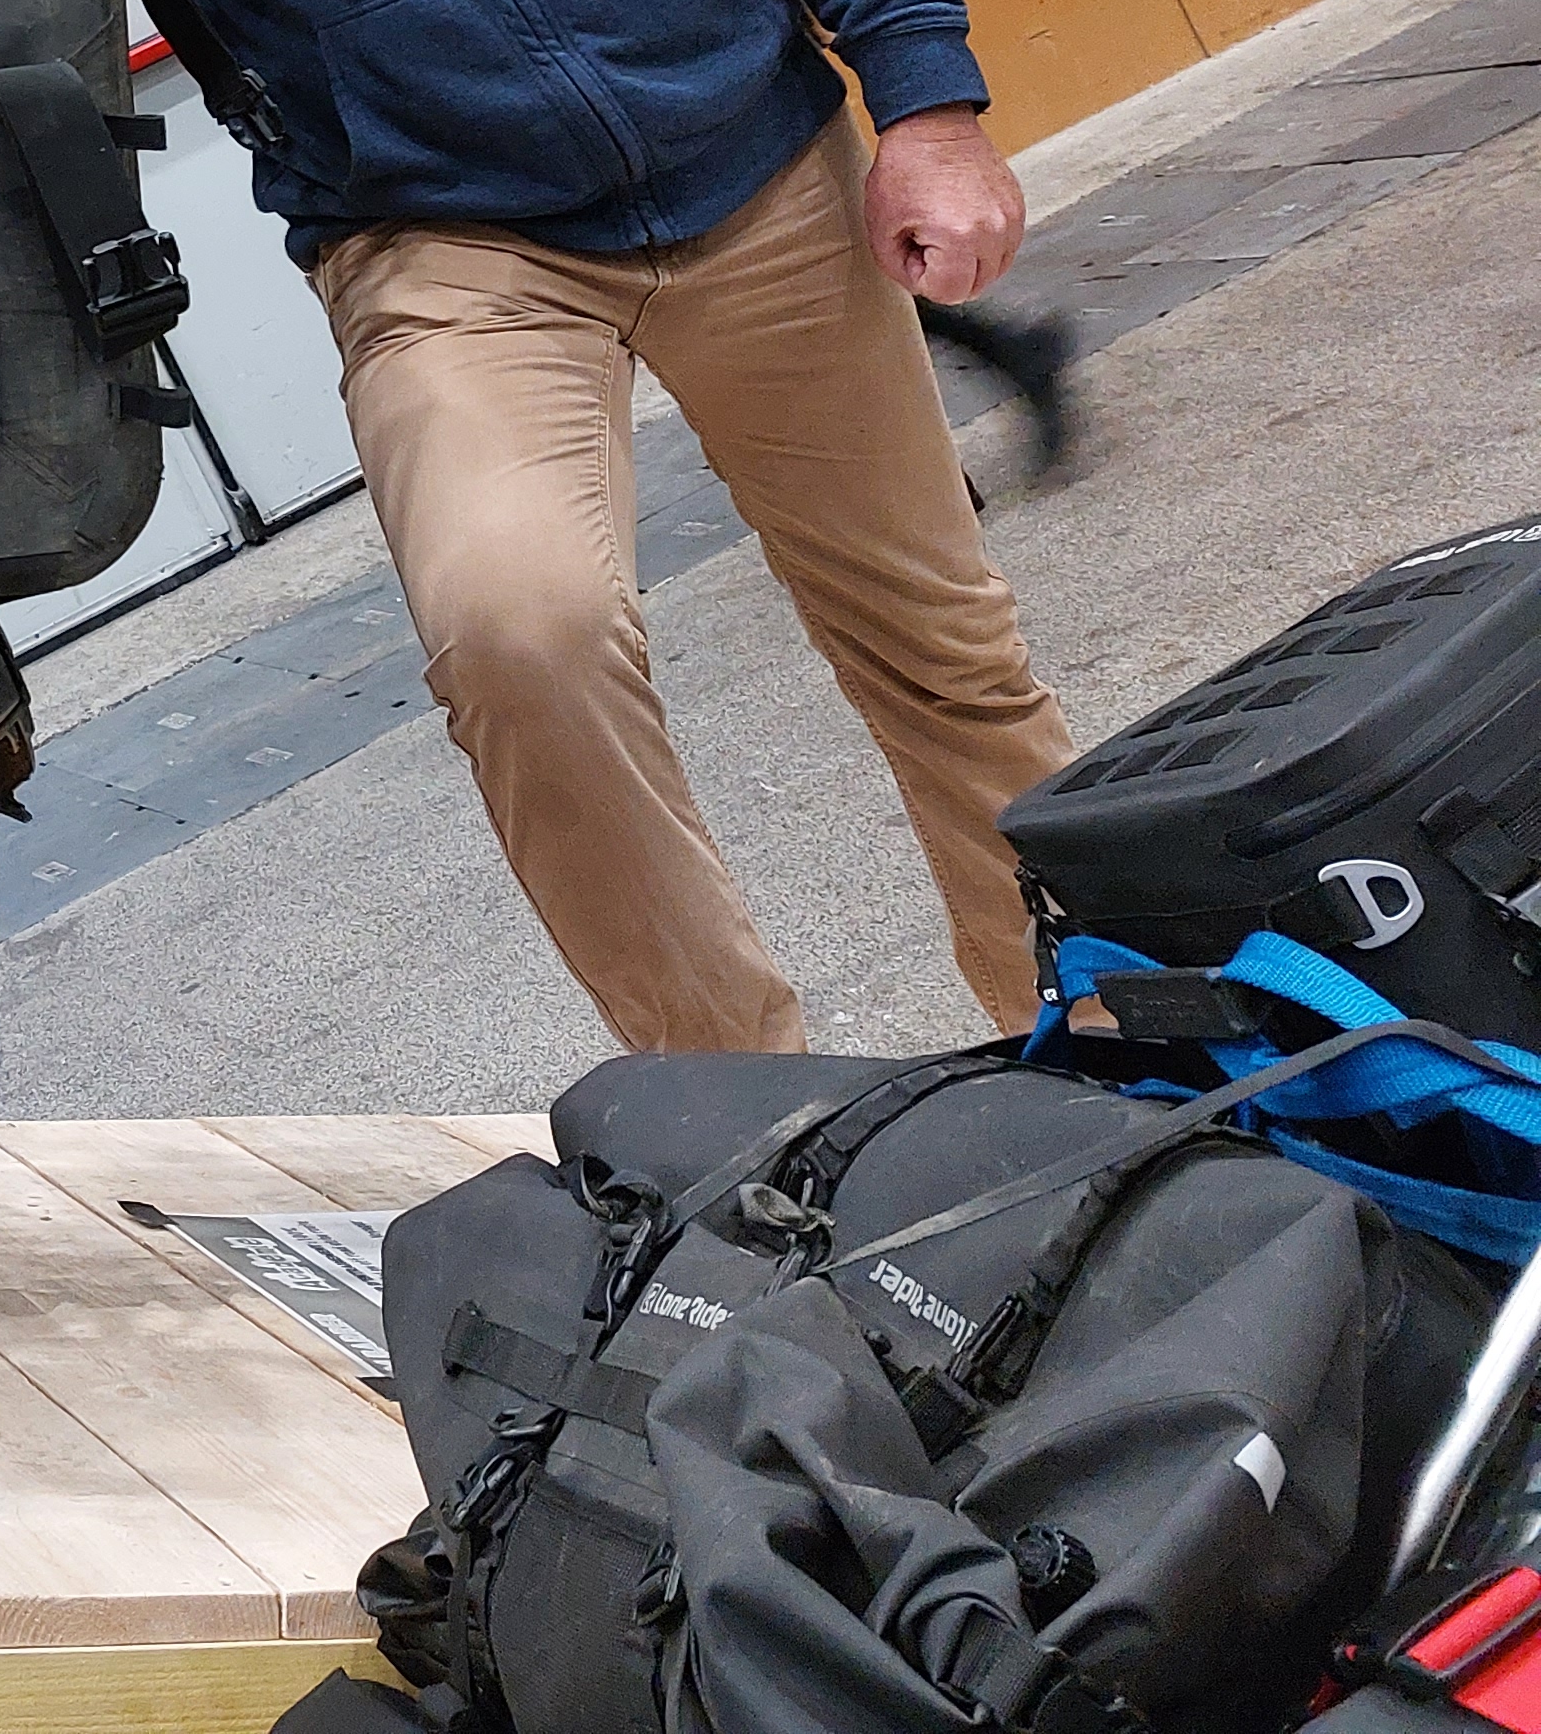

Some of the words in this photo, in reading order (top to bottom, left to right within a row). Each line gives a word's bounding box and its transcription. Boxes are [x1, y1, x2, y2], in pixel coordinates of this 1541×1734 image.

[653, 1286, 693, 1320] Lone
[688, 1296, 735, 1331] Ride
[868, 1258, 925, 1319] Rider
